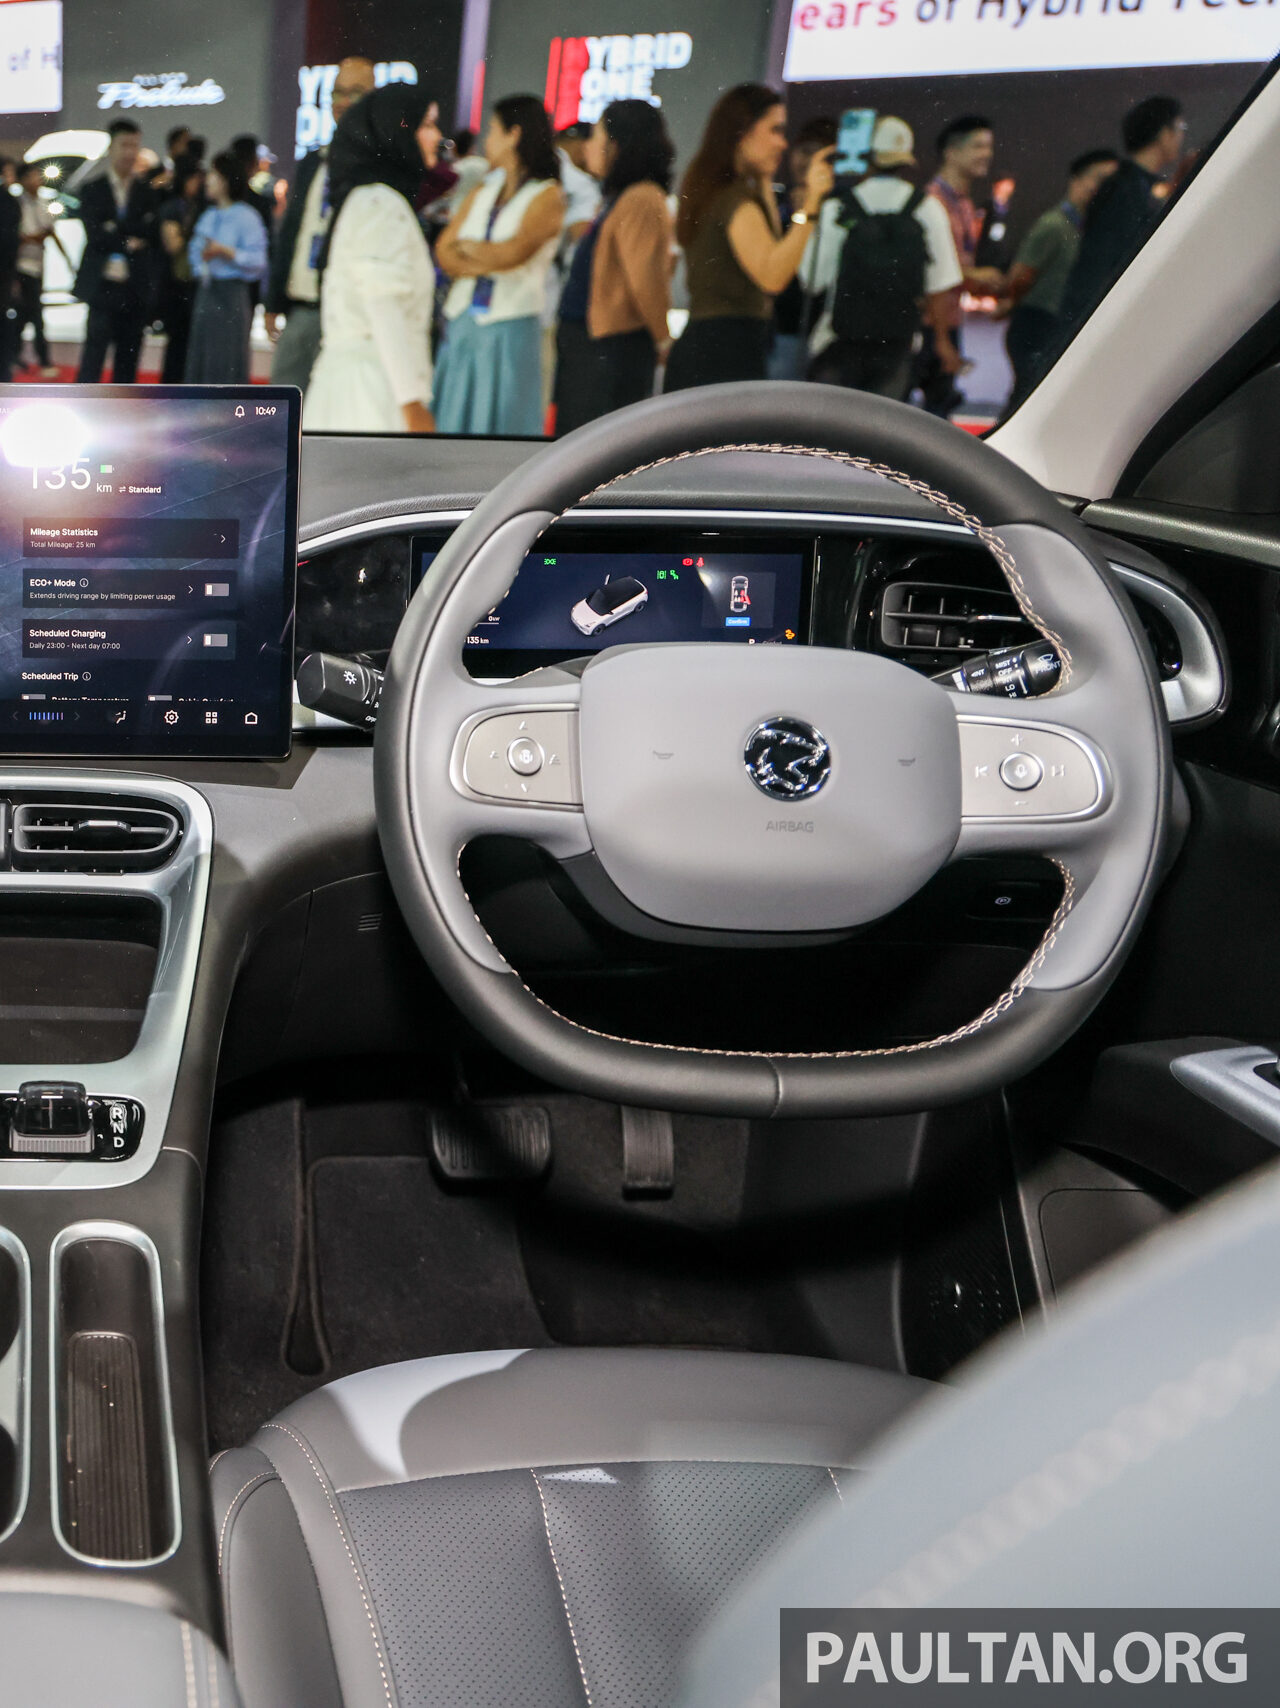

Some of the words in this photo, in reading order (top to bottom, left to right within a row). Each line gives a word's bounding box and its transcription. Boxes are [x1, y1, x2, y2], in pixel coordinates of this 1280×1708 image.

[255, 406, 277, 416] 10:49
[32, 457, 91, 490] 135
[96, 483, 113, 493] km
[128, 486, 162, 494] Standard
[30, 528, 60, 537] Mileage
[62, 528, 99, 536] Statistics
[47, 541, 75, 549] Mileage:
[29, 579, 52, 587] ECO+
[54, 579, 76, 587] Mode
[57, 592, 79, 600] driving
[100, 592, 109, 600] by
[110, 592, 133, 600] limiting
[29, 629, 70, 637] Scheduled
[71, 629, 106, 639] Charging
[466, 636, 480, 645] 135
[29, 642, 45, 650] Daily
[88, 642, 100, 650] day
[21, 672, 62, 680] Scheduled
[63, 672, 79, 682] Trip
[765, 820, 815, 834] AIRBAG
[112, 1106, 124, 1120] R
[112, 1121, 125, 1134] N
[113, 1136, 125, 1148] D
